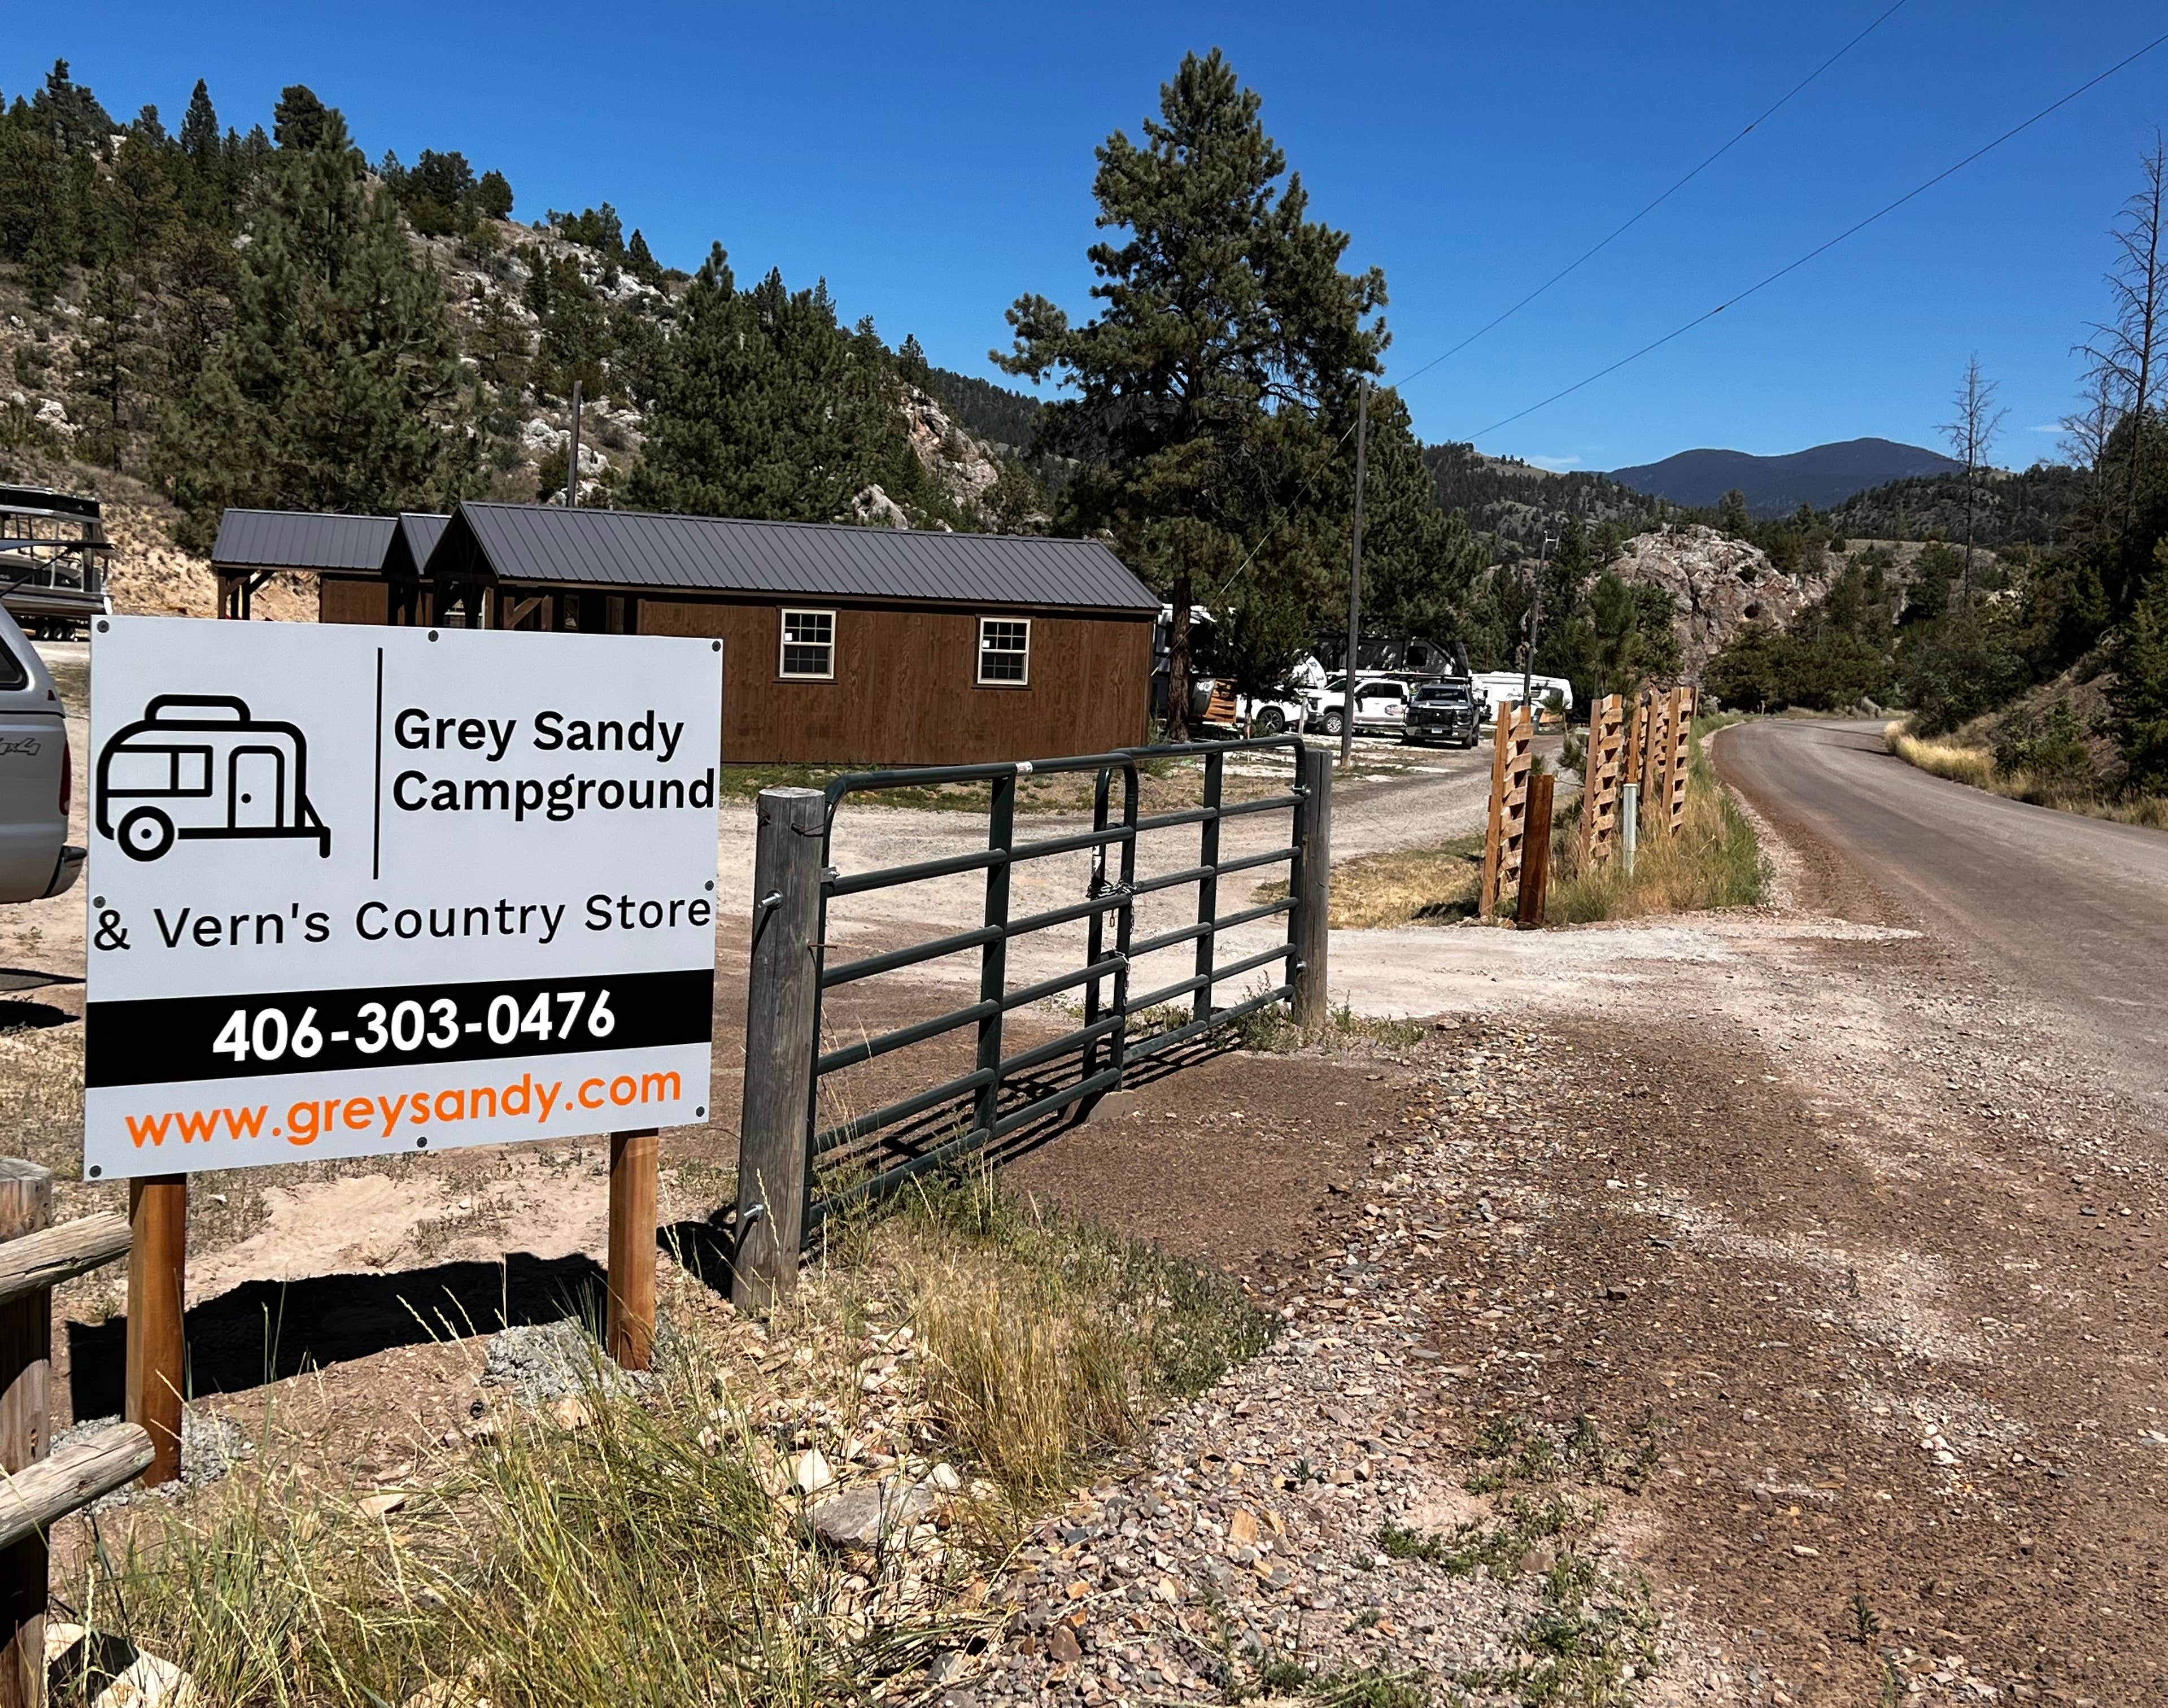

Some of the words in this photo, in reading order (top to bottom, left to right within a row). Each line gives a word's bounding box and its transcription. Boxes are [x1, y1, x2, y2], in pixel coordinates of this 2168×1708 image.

[394, 708, 517, 762] Grey
[533, 709, 685, 763] Sandy
[392, 767, 715, 822] Campground
[93, 909, 131, 952] &
[152, 902, 330, 949] Vern's
[355, 898, 566, 944] Country
[584, 894, 711, 931] Store
[212, 988, 616, 1062] 406-303-0476
[125, 1070, 682, 1149] www.greysandy.com
